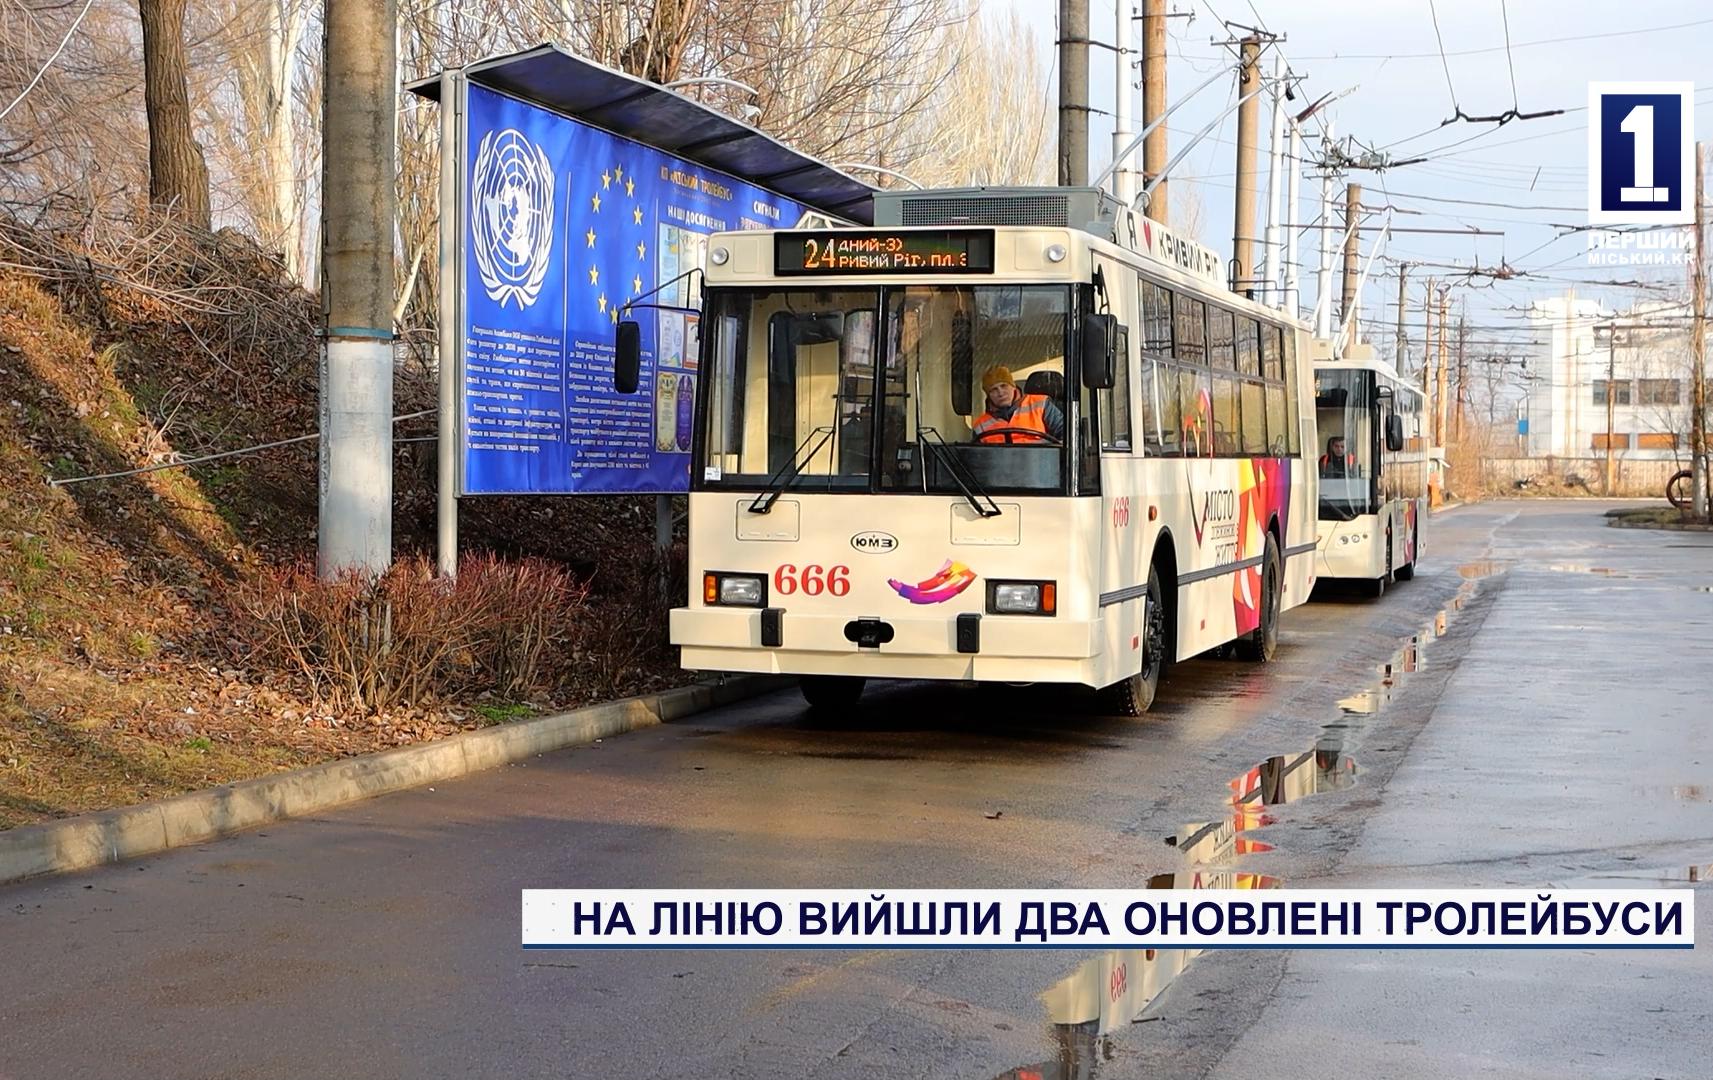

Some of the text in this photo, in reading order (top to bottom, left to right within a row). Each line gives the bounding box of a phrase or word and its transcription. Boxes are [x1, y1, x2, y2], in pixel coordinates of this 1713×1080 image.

[804, 238, 837, 269] 24
[1126, 211, 1137, 250] Я
[1157, 229, 1204, 274] КРИВИЙ
[1113, 496, 1130, 529] 666
[855, 536, 895, 548] ЮМЗ
[773, 563, 851, 597] 666
